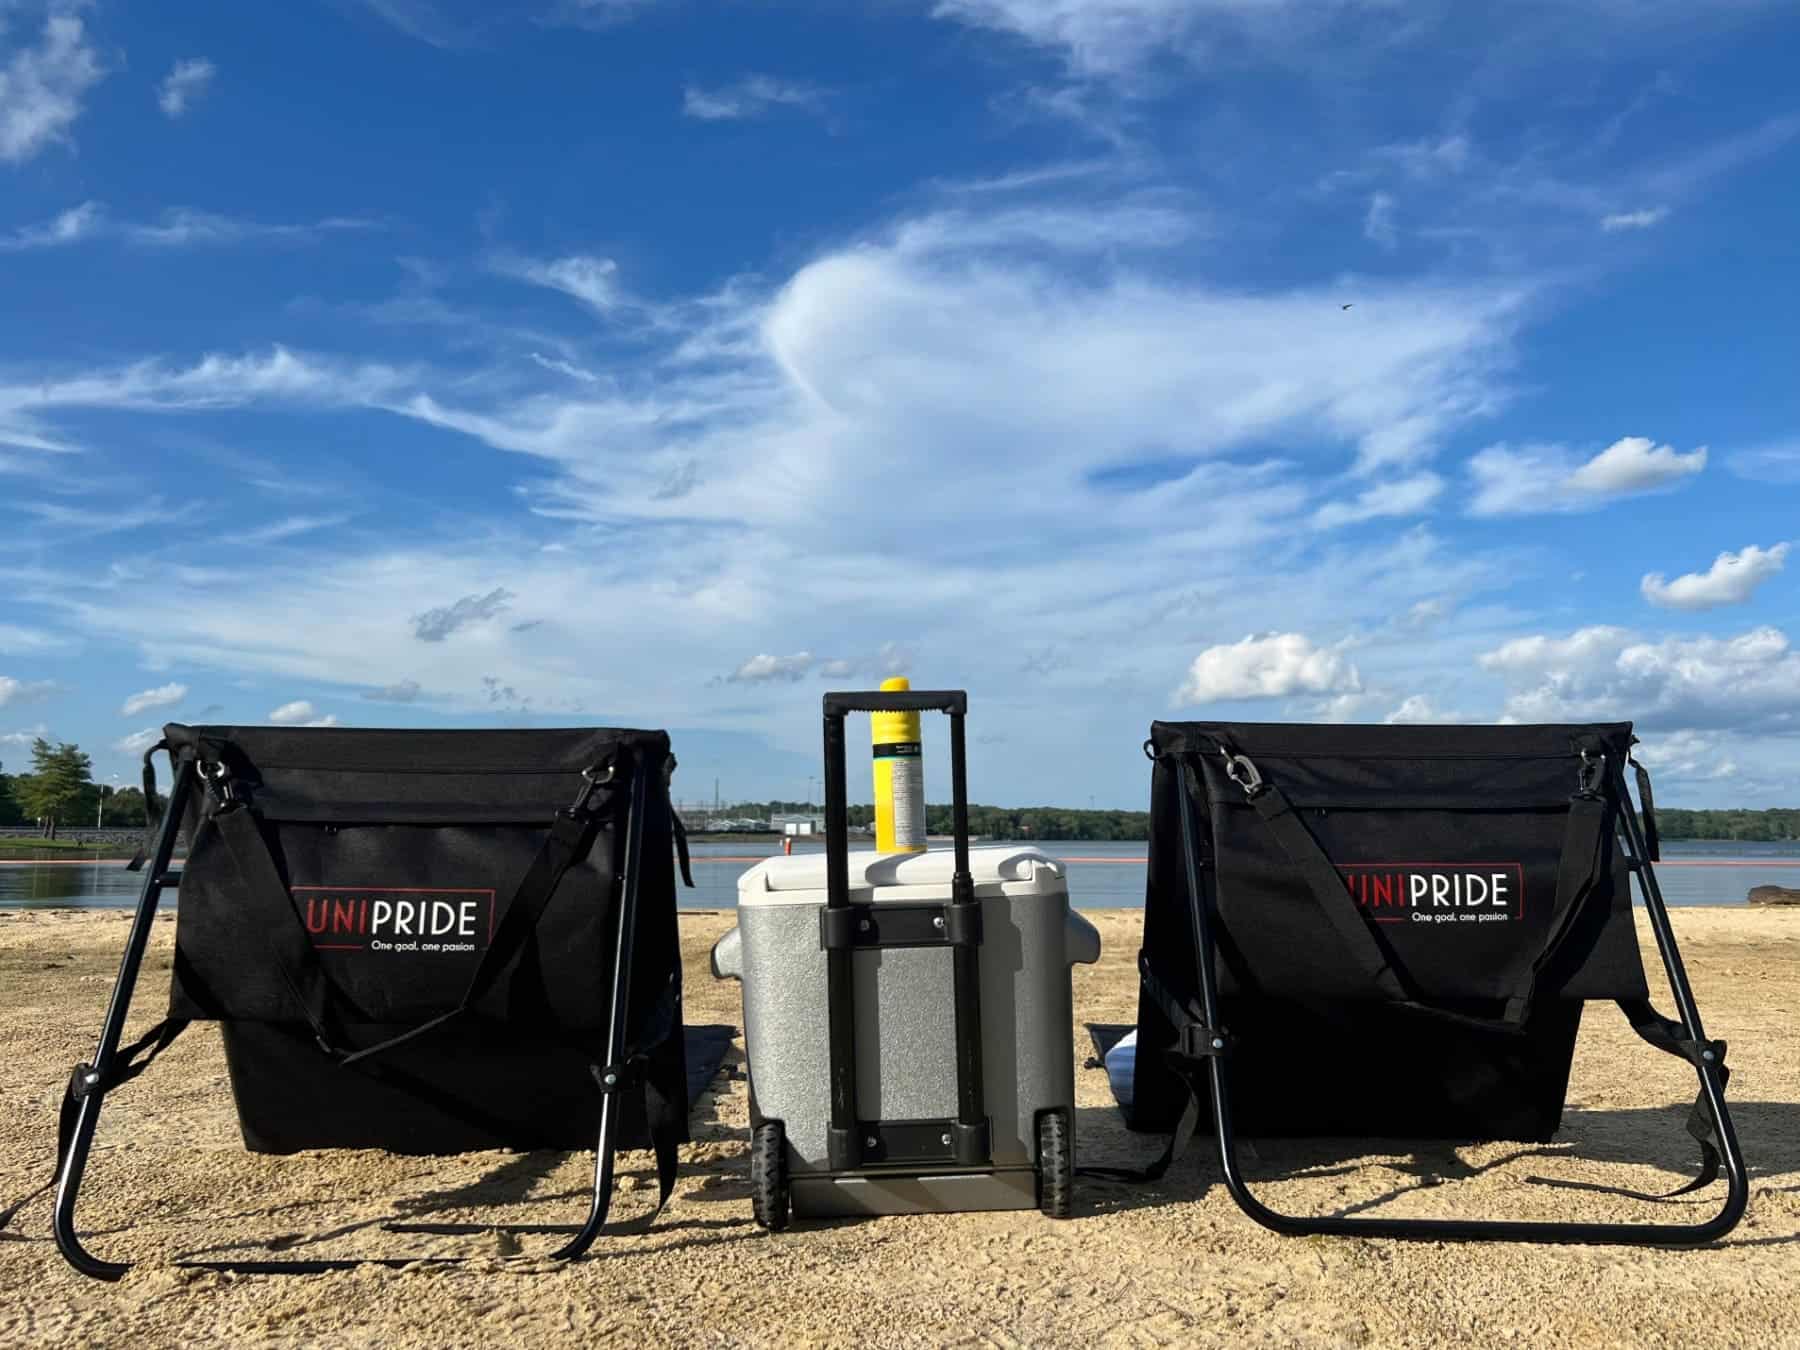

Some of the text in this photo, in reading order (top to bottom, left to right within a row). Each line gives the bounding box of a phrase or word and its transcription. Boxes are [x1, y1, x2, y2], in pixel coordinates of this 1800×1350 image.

[306, 898, 477, 935] UNIPRIDE
[1411, 911, 1433, 922] One
[1459, 913, 1476, 922] one
[371, 939, 392, 951] One
[422, 942, 440, 951] one
